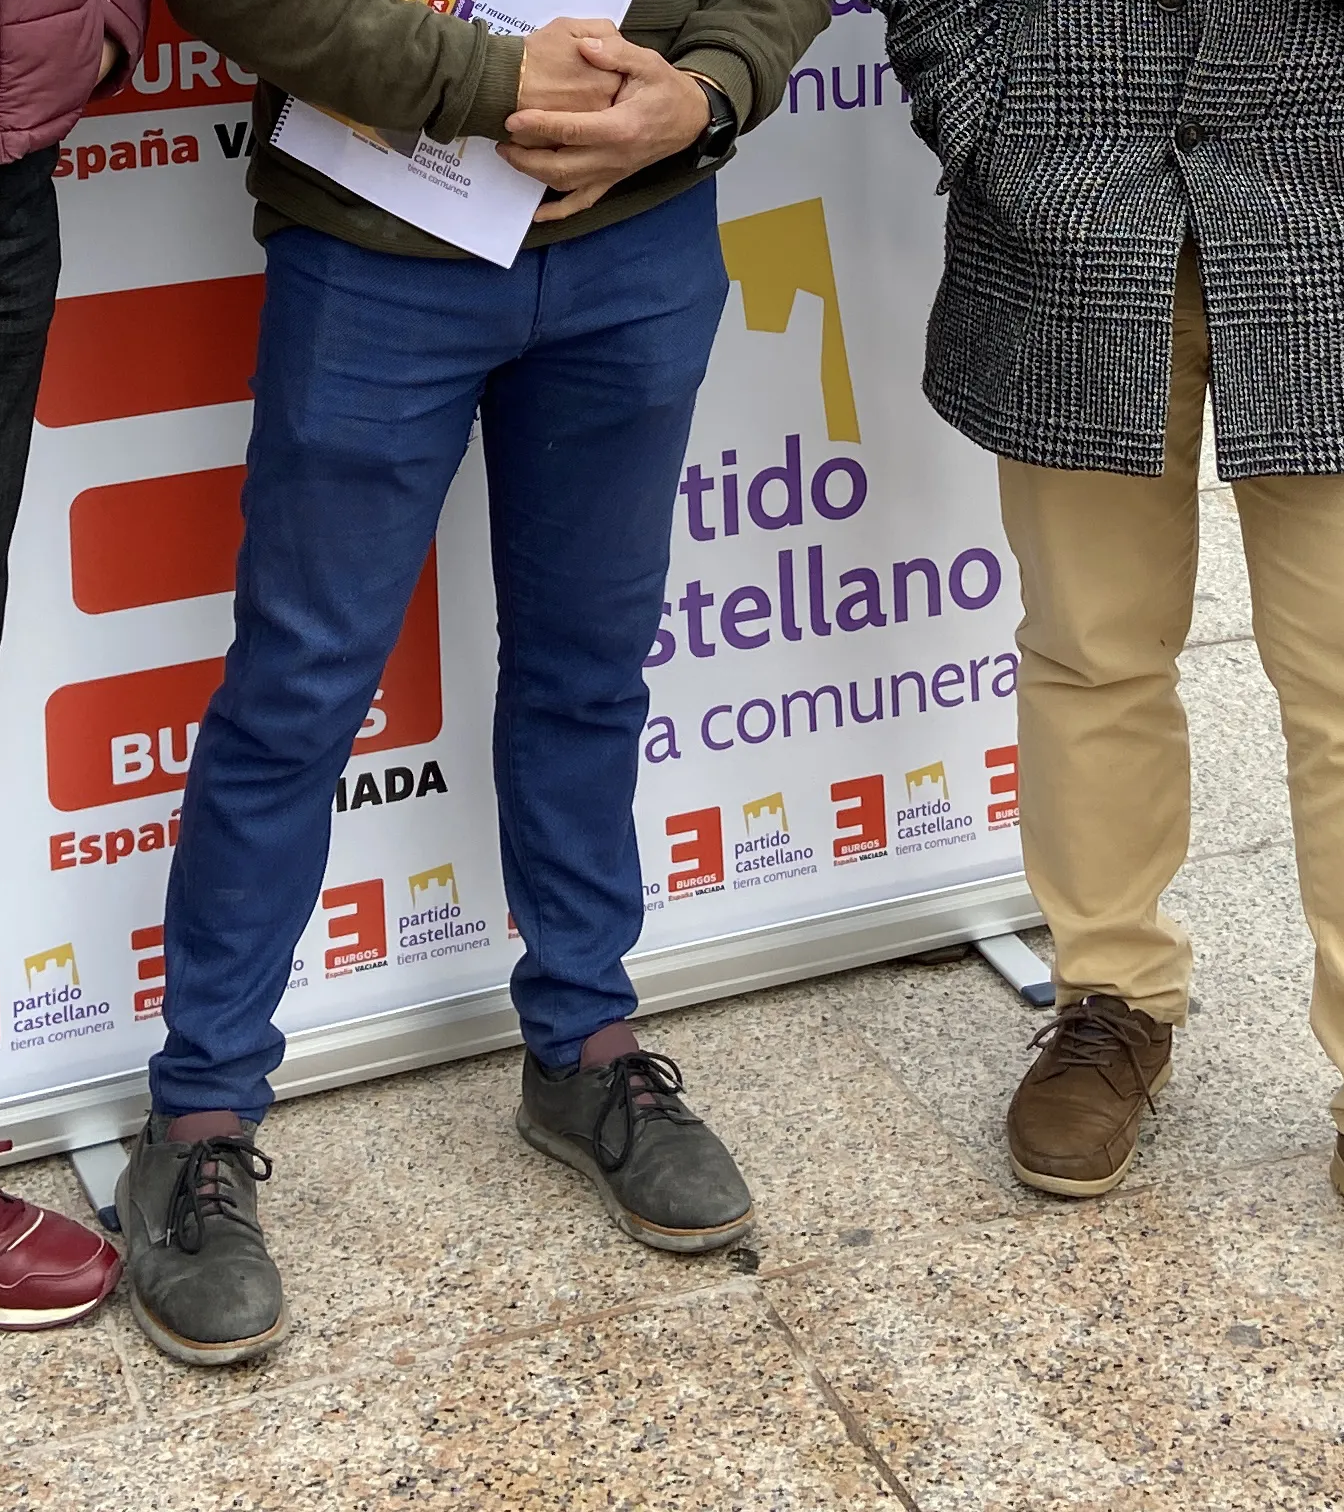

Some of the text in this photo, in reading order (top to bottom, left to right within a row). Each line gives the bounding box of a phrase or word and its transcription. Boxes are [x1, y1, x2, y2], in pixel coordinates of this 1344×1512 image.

[52, 128, 200, 180] spaña
[418, 141, 461, 168] partido
[413, 153, 471, 187] castellano
[680, 434, 867, 541] tido
[642, 544, 1001, 667] stellano
[701, 652, 1020, 751] comunera
[50, 761, 448, 871] Espa IADA
[897, 799, 950, 826] partido
[995, 808, 1019, 820] BURG
[898, 814, 972, 839] castellano
[735, 830, 790, 859] partido
[841, 839, 880, 854] BURGOS
[859, 850, 888, 861] VACIADA
[896, 831, 976, 856] tierra comunera
[736, 847, 813, 873] castellano
[676, 873, 716, 889] BURGOS
[733, 864, 817, 889] tierra comunera
[695, 885, 725, 896] VACIADA
[399, 903, 461, 933] partido
[400, 921, 486, 948] castellano
[334, 948, 379, 966] BURGOS
[397, 937, 490, 965] tierra comunera
[355, 960, 388, 972] VACIADA
[13, 984, 82, 1018] partido
[13, 1001, 110, 1033] castellano
[10, 1020, 115, 1052] tierra comunera
